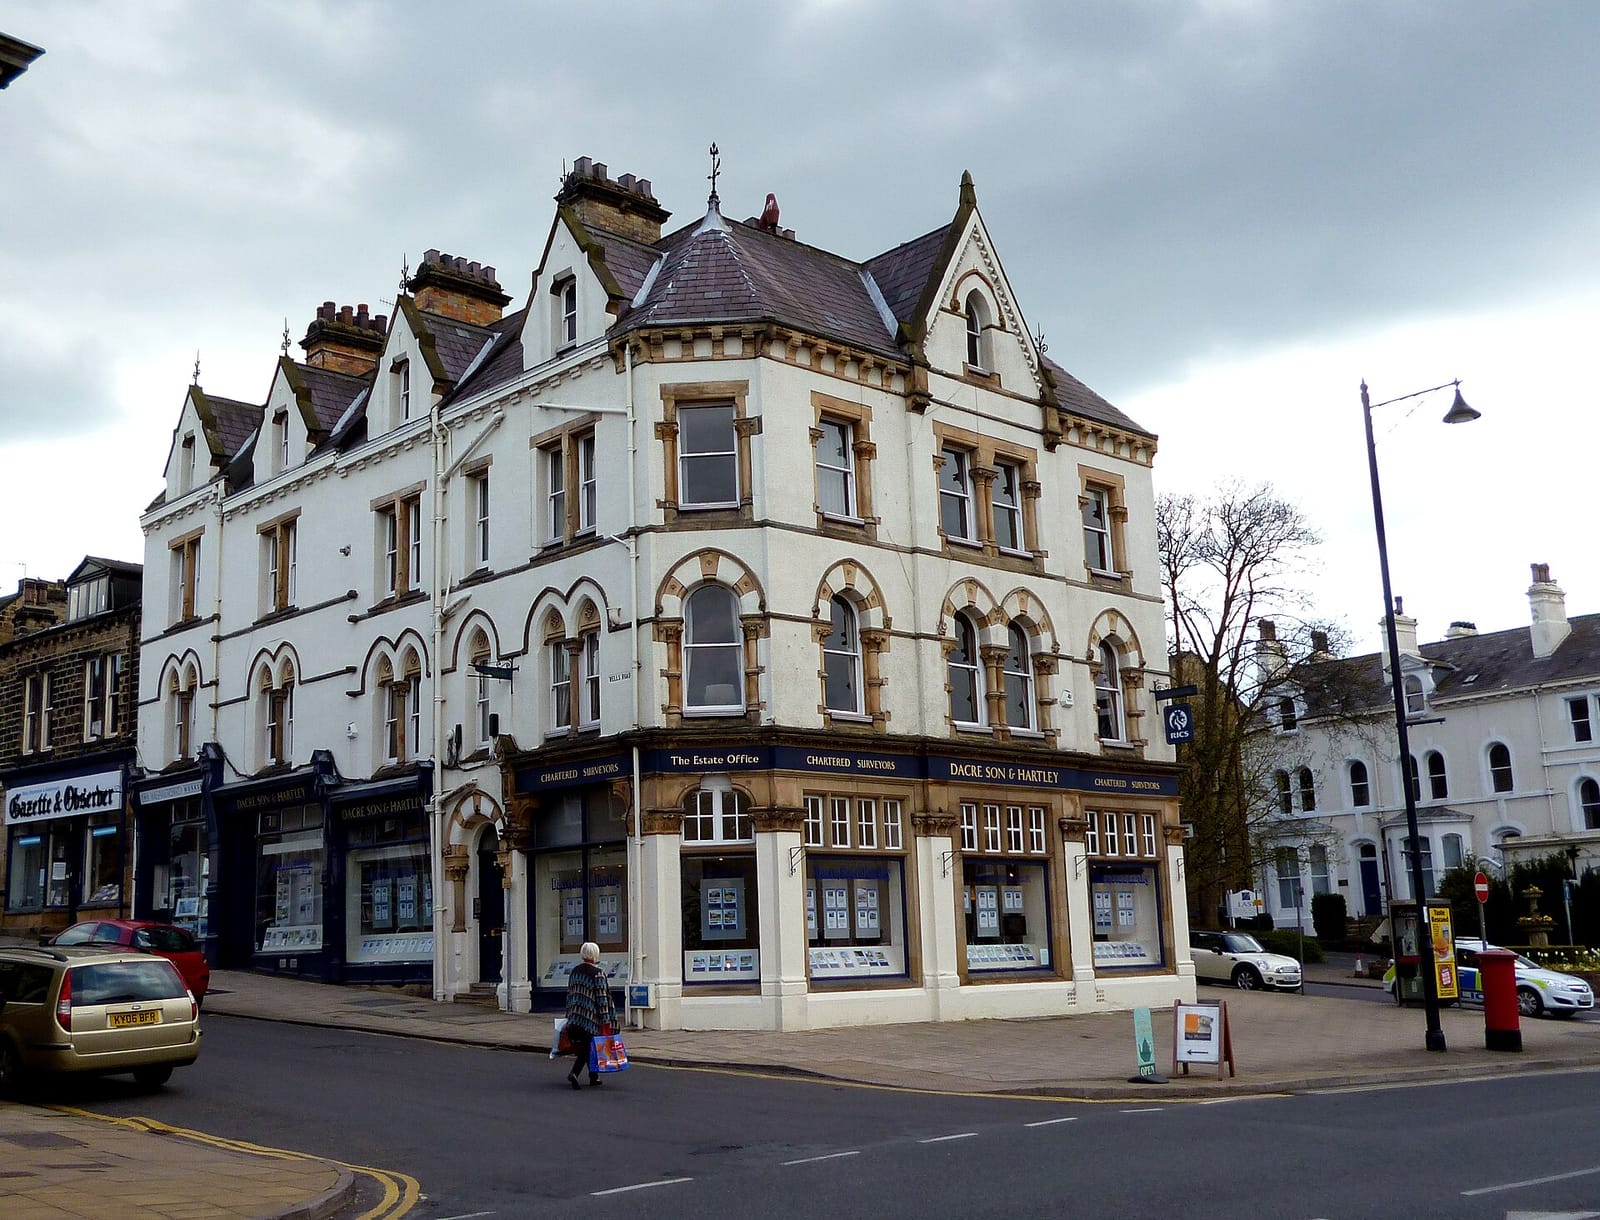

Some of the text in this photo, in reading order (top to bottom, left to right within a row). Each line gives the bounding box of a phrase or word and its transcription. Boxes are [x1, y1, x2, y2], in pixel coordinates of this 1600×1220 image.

[1170, 730, 1190, 739] RICS
[670, 754, 760, 766] The Estate Office
[806, 755, 896, 770] CHARTERED SURVEYORS
[540, 763, 619, 783] CHARTERED SURVEYORS
[950, 762, 1059, 784] DACRE SON & HARTLEY
[1094, 778, 1160, 790] CHARTERED SURVEYORS
[9, 792, 52, 819] Gazette
[53, 789, 62, 813] &
[64, 784, 114, 812] Observer
[342, 806, 366, 819] DACRE
[366, 803, 383, 816] SON
[390, 796, 425, 812] HARTLEY
[114, 1014, 137, 1025] KY06
[1140, 1065, 1155, 1077] OPEN
